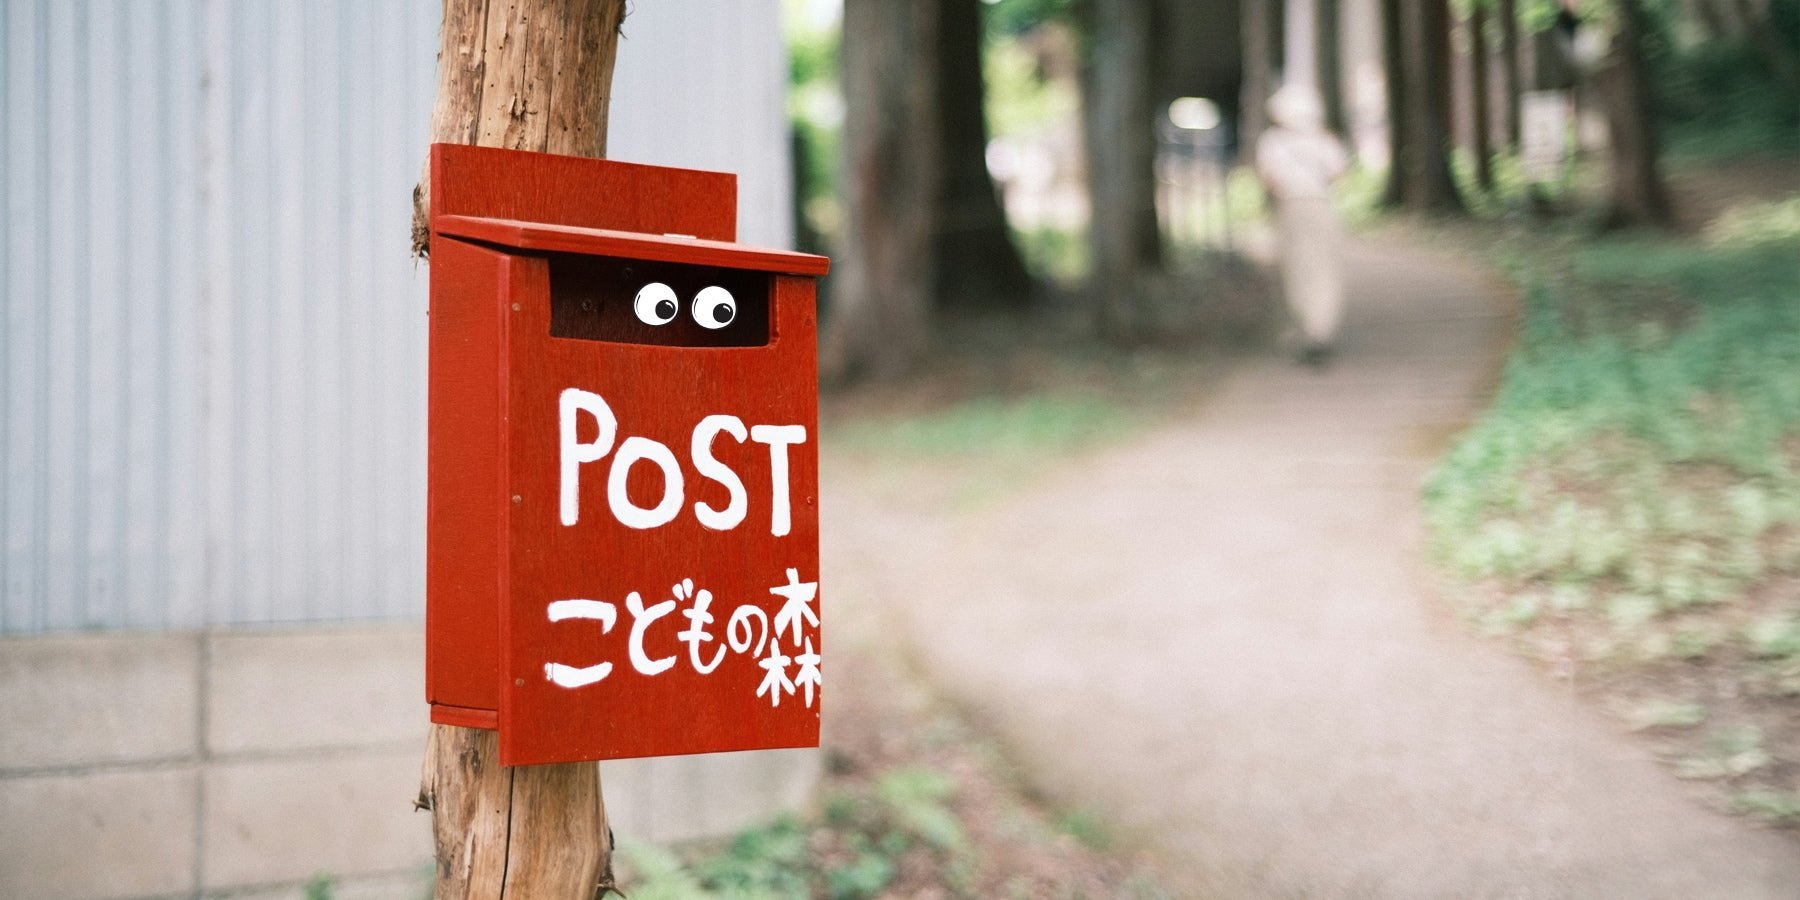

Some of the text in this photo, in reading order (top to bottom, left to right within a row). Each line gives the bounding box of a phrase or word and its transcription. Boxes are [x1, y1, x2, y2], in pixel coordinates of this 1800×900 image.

[544, 567, 822, 709] こどもの森
